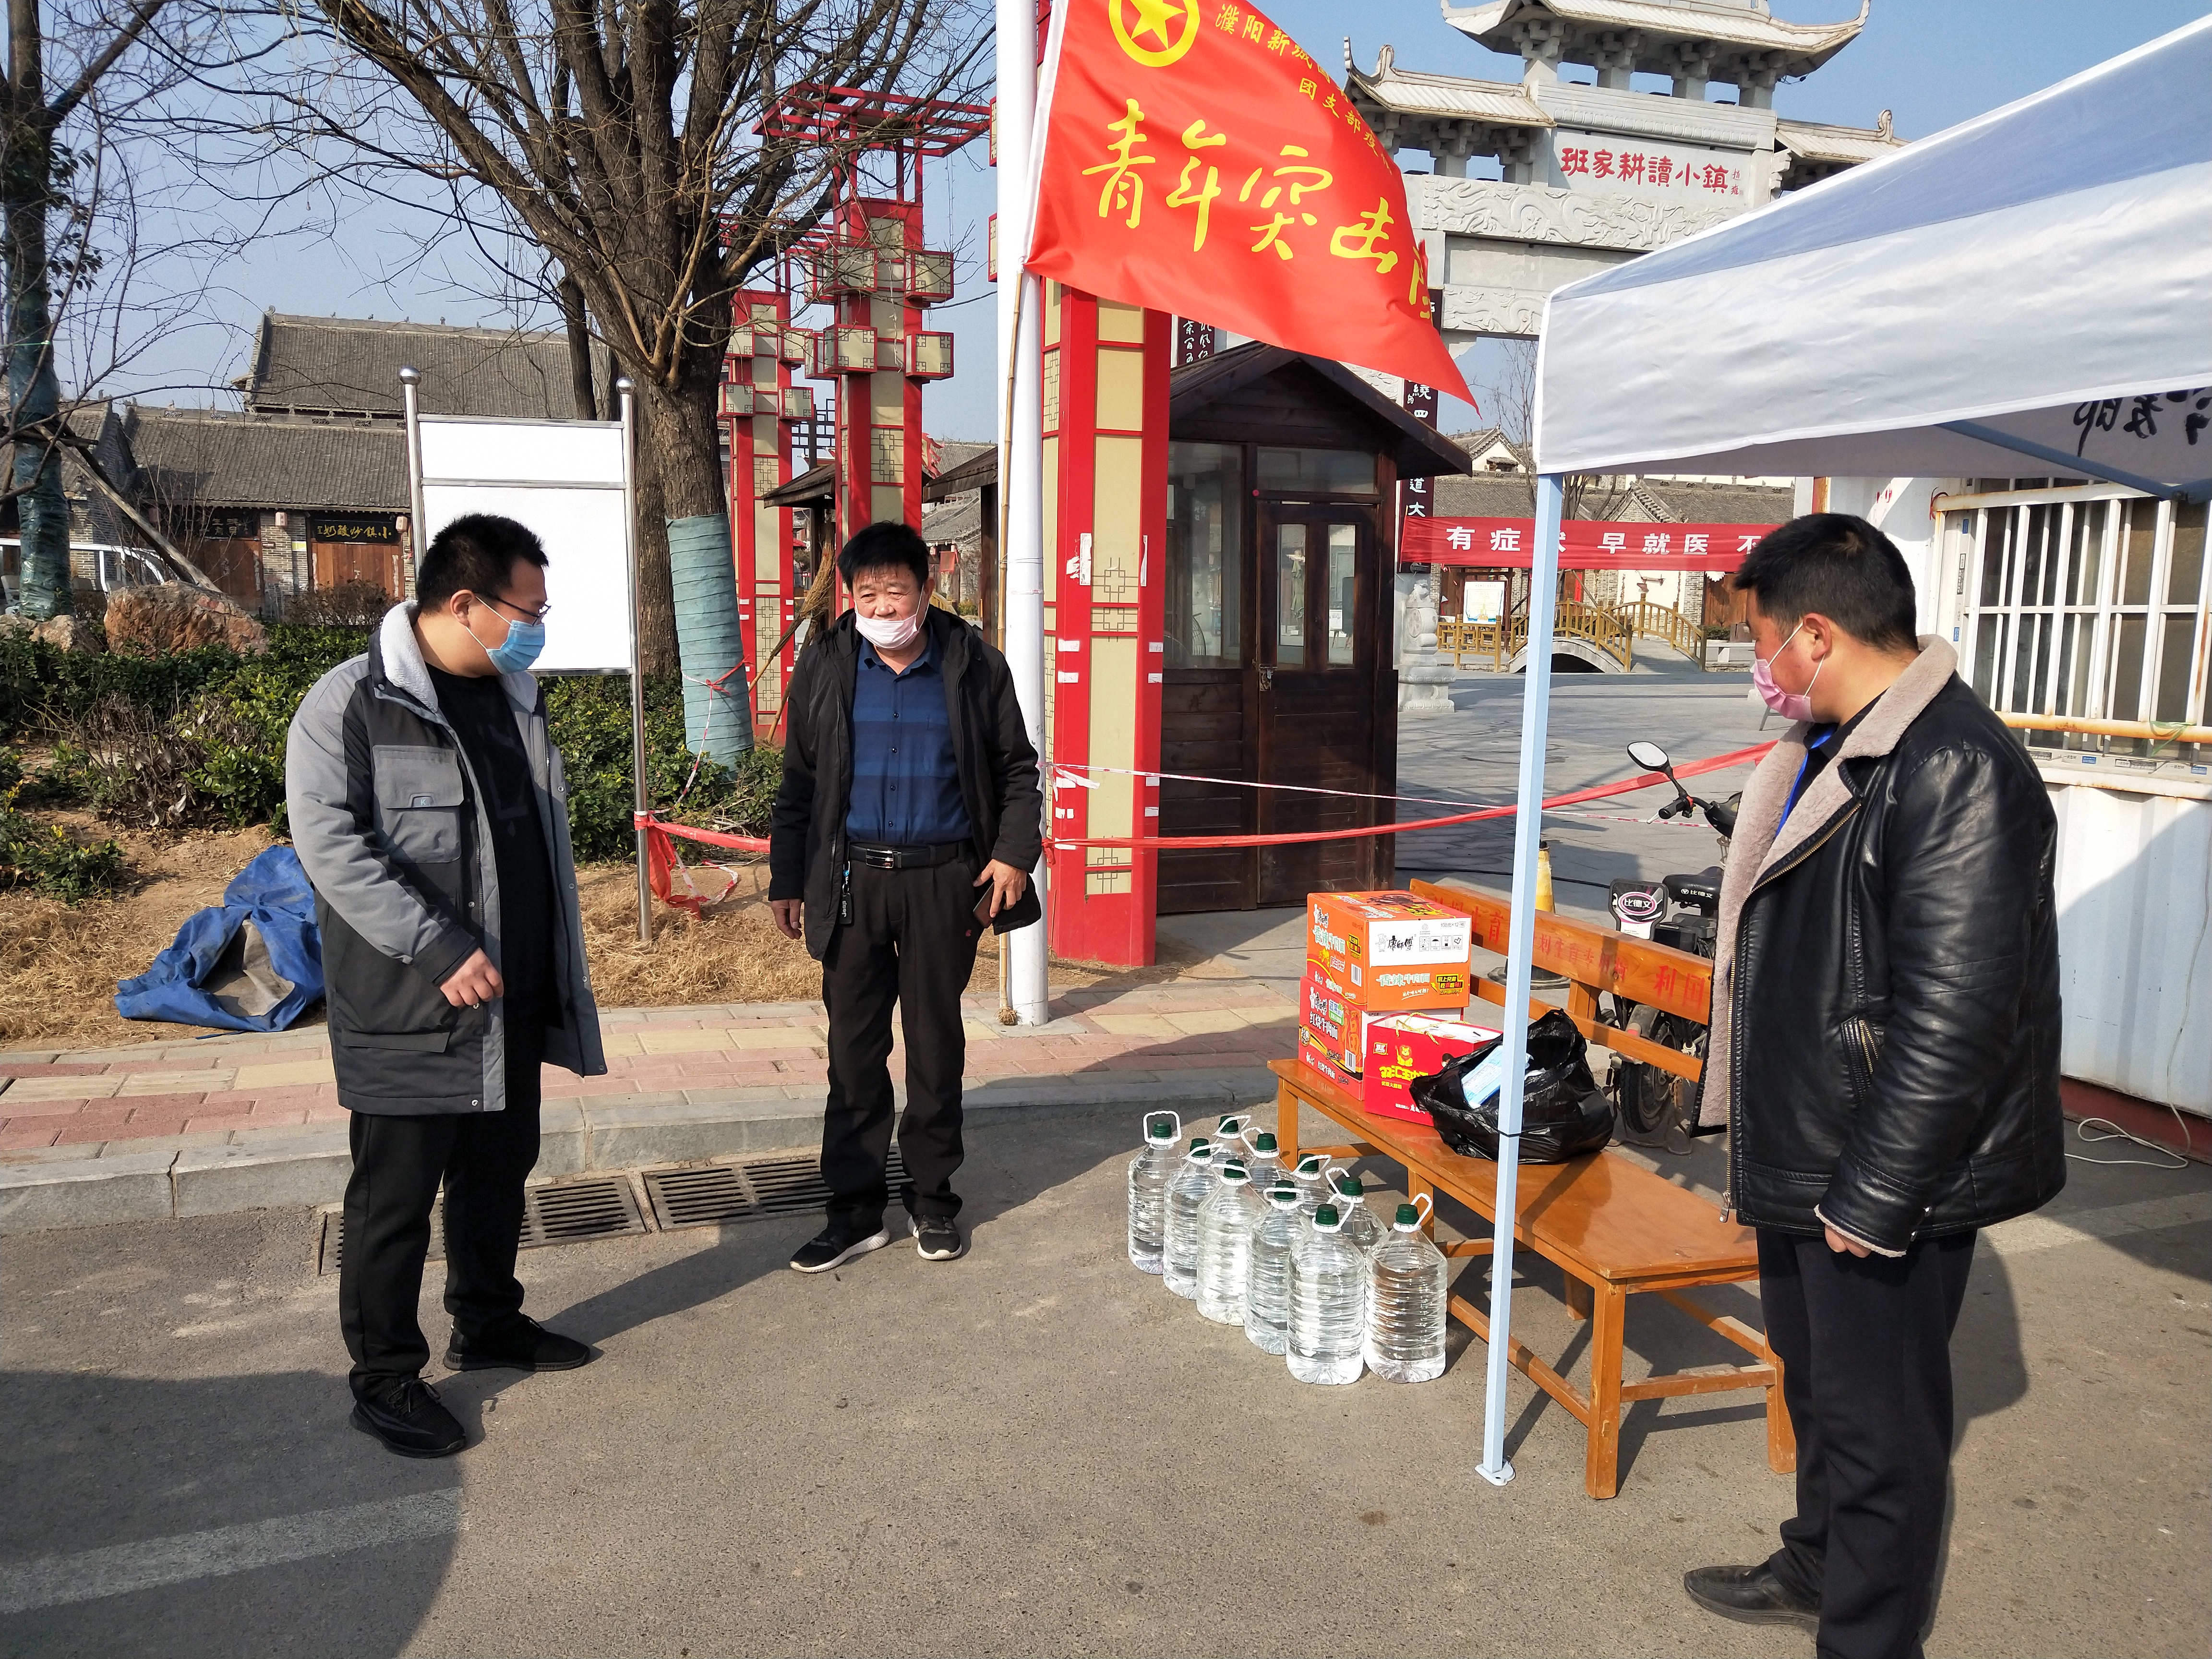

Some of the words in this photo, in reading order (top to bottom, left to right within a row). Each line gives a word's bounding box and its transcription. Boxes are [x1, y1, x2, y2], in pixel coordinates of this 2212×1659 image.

[1561, 147, 1729, 194] 班家耕讀小鎮
[1598, 532, 1709, 555] 早就医
[1736, 535, 1762, 554] 不
[1624, 898, 1652, 909] 比德文
[1690, 890, 1714, 899] 比德文
[1313, 925, 1346, 955] 香辣牛肉面
[1376, 974, 1431, 987] 香辣牛肉面
[1309, 1010, 1338, 1041] 红烧牛肉面
